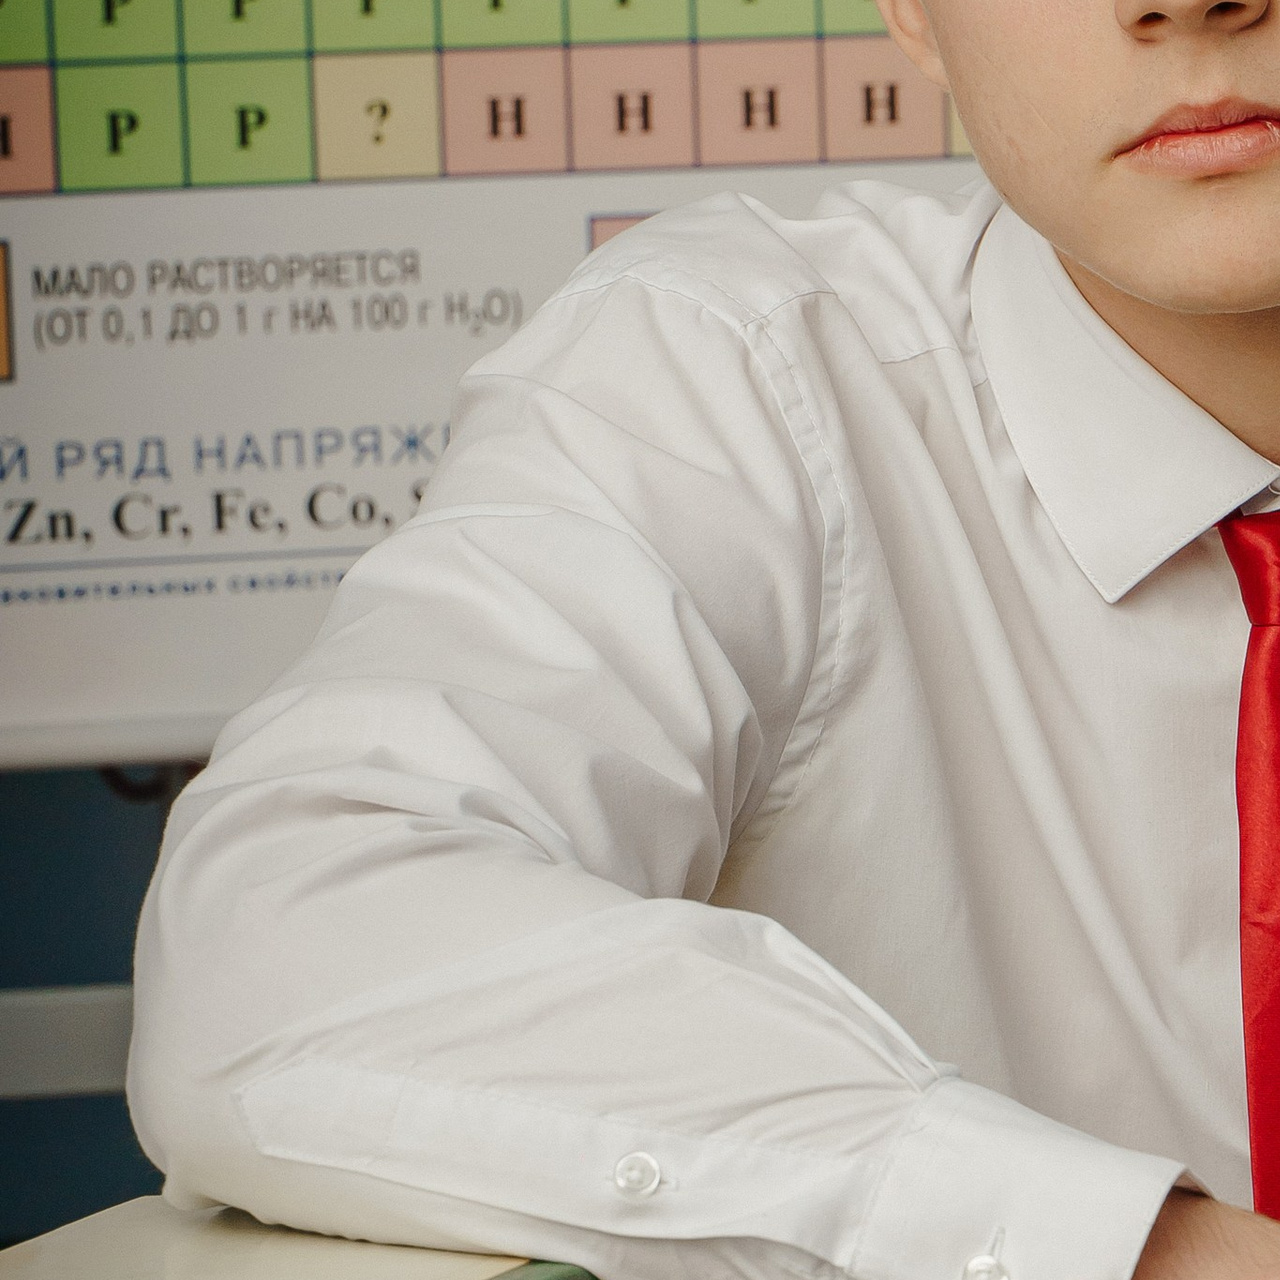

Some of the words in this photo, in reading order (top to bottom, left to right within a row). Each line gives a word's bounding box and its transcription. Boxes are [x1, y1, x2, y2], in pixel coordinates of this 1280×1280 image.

[32, 259, 136, 301] МАЛО
[147, 248, 421, 297] РАСТВОРЯЕТСЯ
[55, 436, 172, 483] РЯД
[193, 423, 450, 476] НАПРЯЖ
